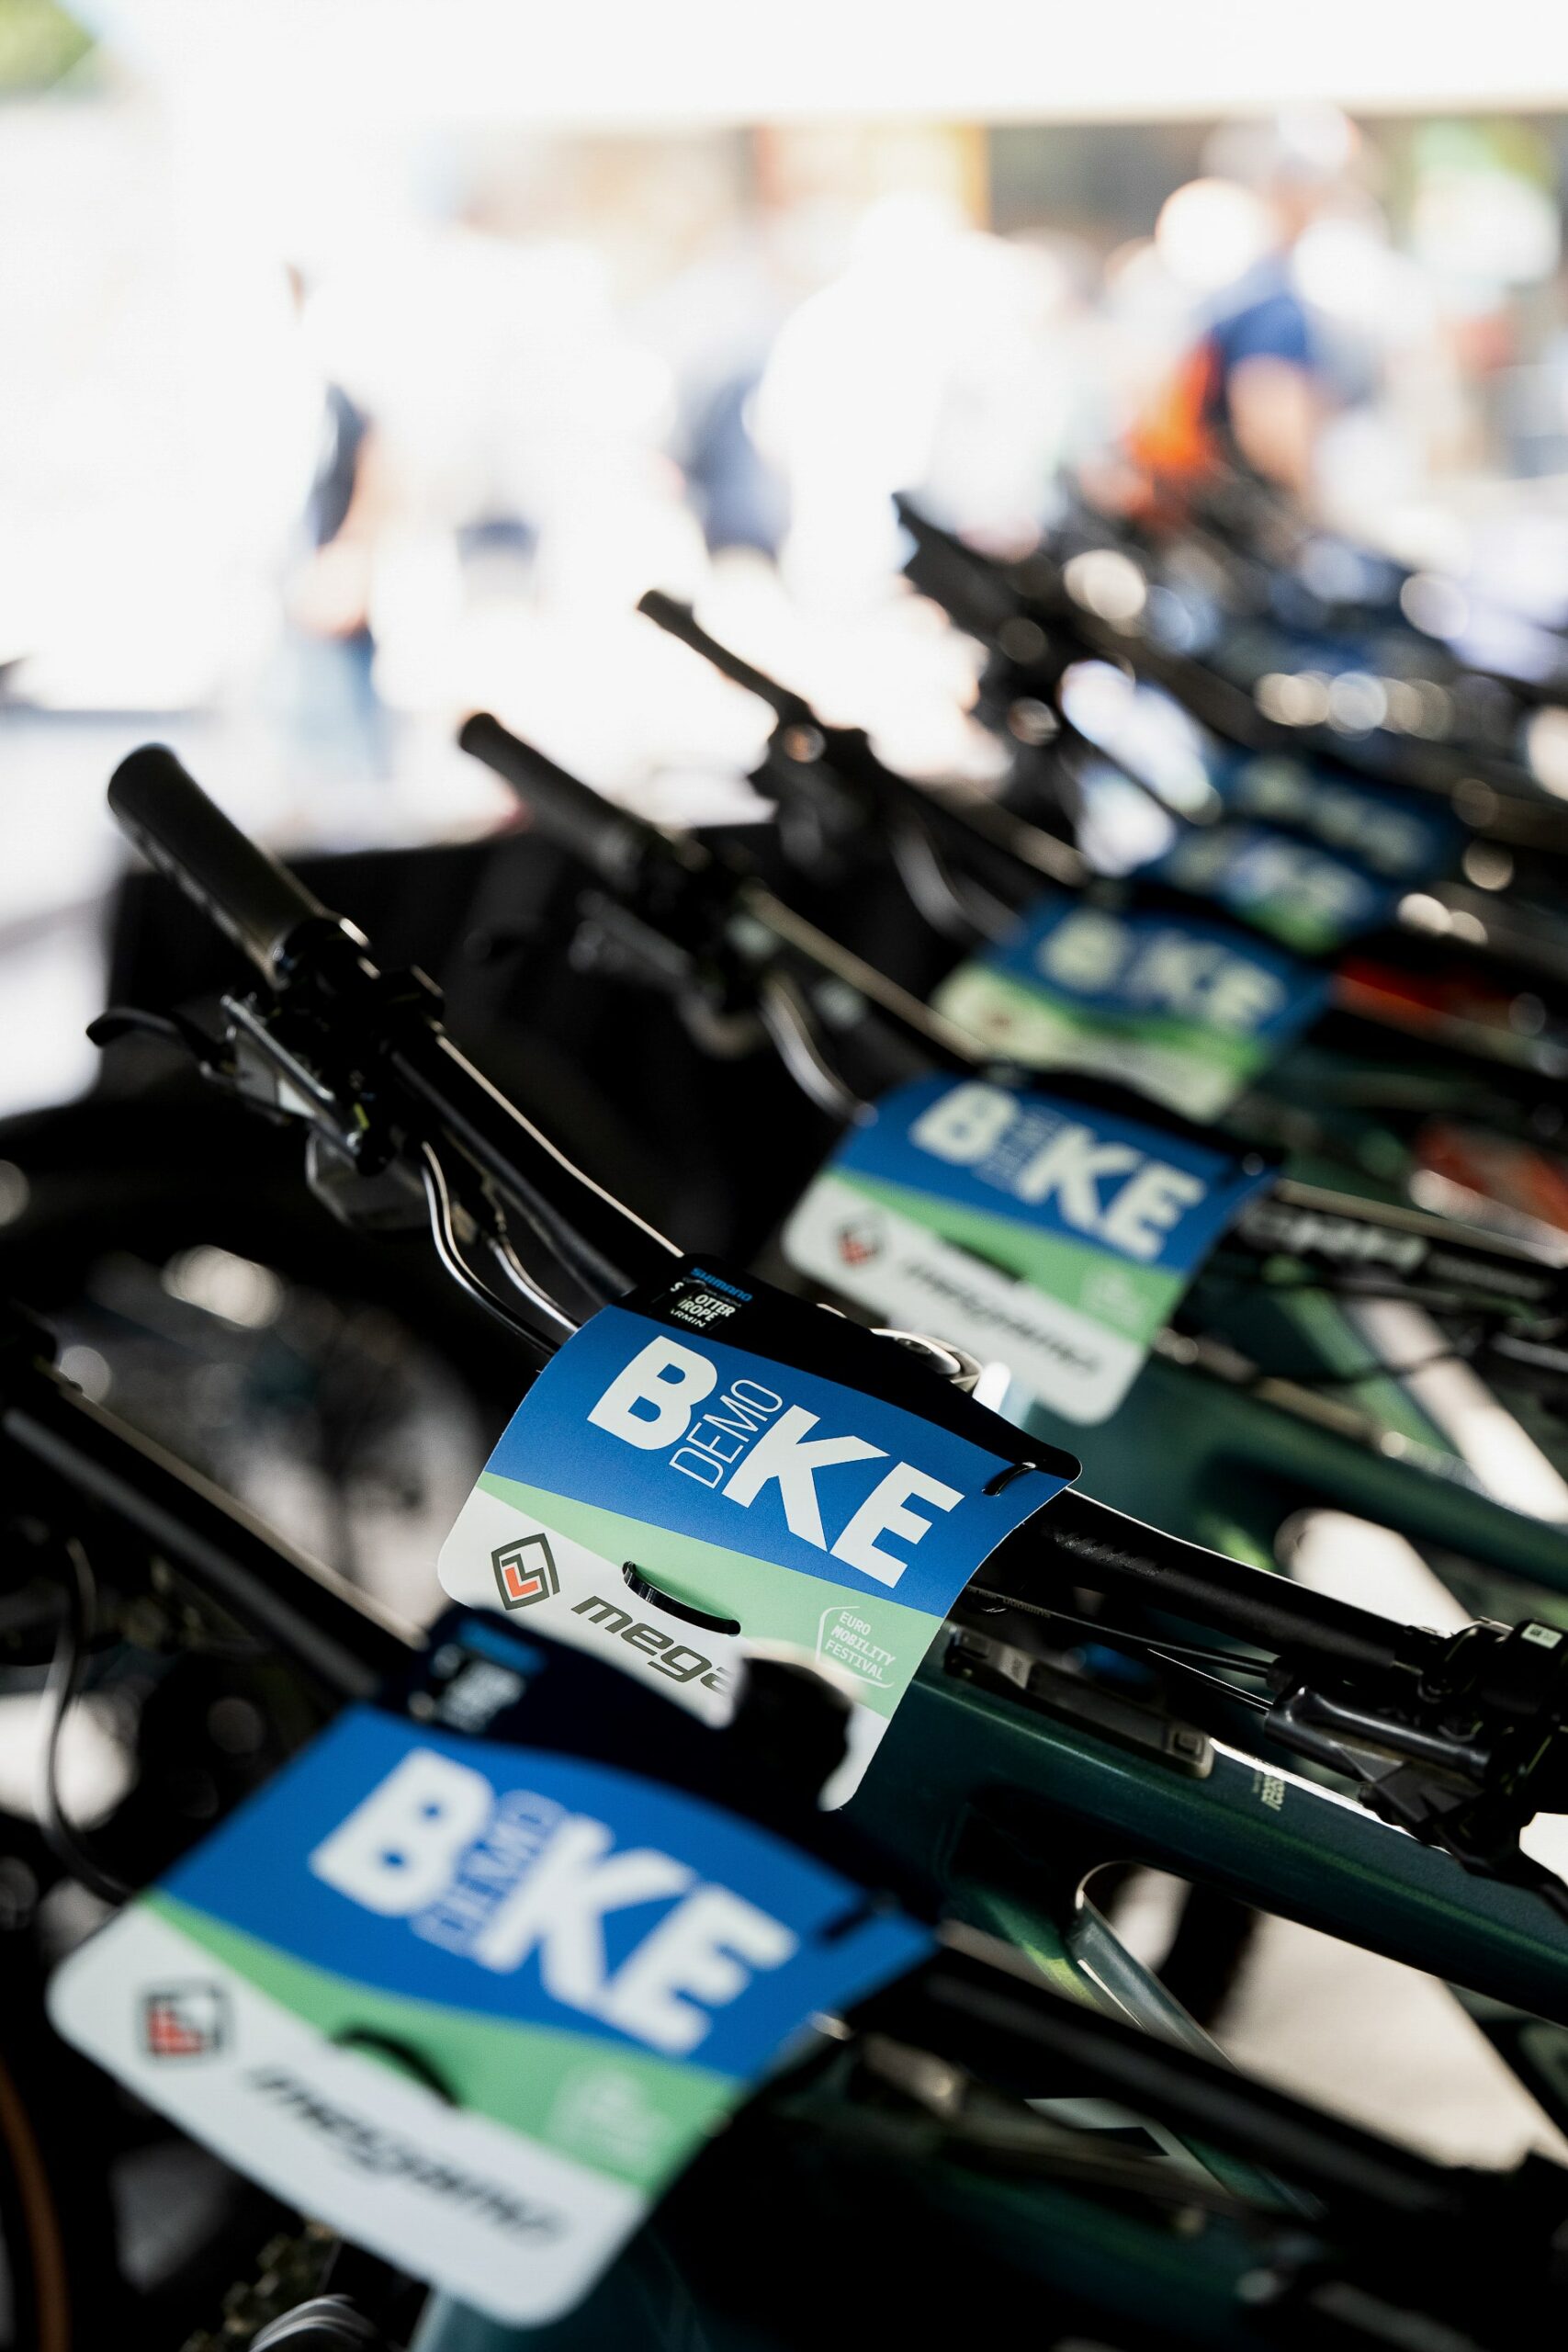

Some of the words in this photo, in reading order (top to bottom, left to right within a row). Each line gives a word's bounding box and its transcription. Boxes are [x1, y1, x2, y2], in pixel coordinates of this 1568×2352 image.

[691, 1267, 753, 1302] SHIMANO
[669, 1379, 783, 1488] DEMO
[839, 1611, 872, 1635] EURO
[825, 1639, 883, 1680] FESTIVAL
[830, 1624, 897, 1666] MOBILITY
